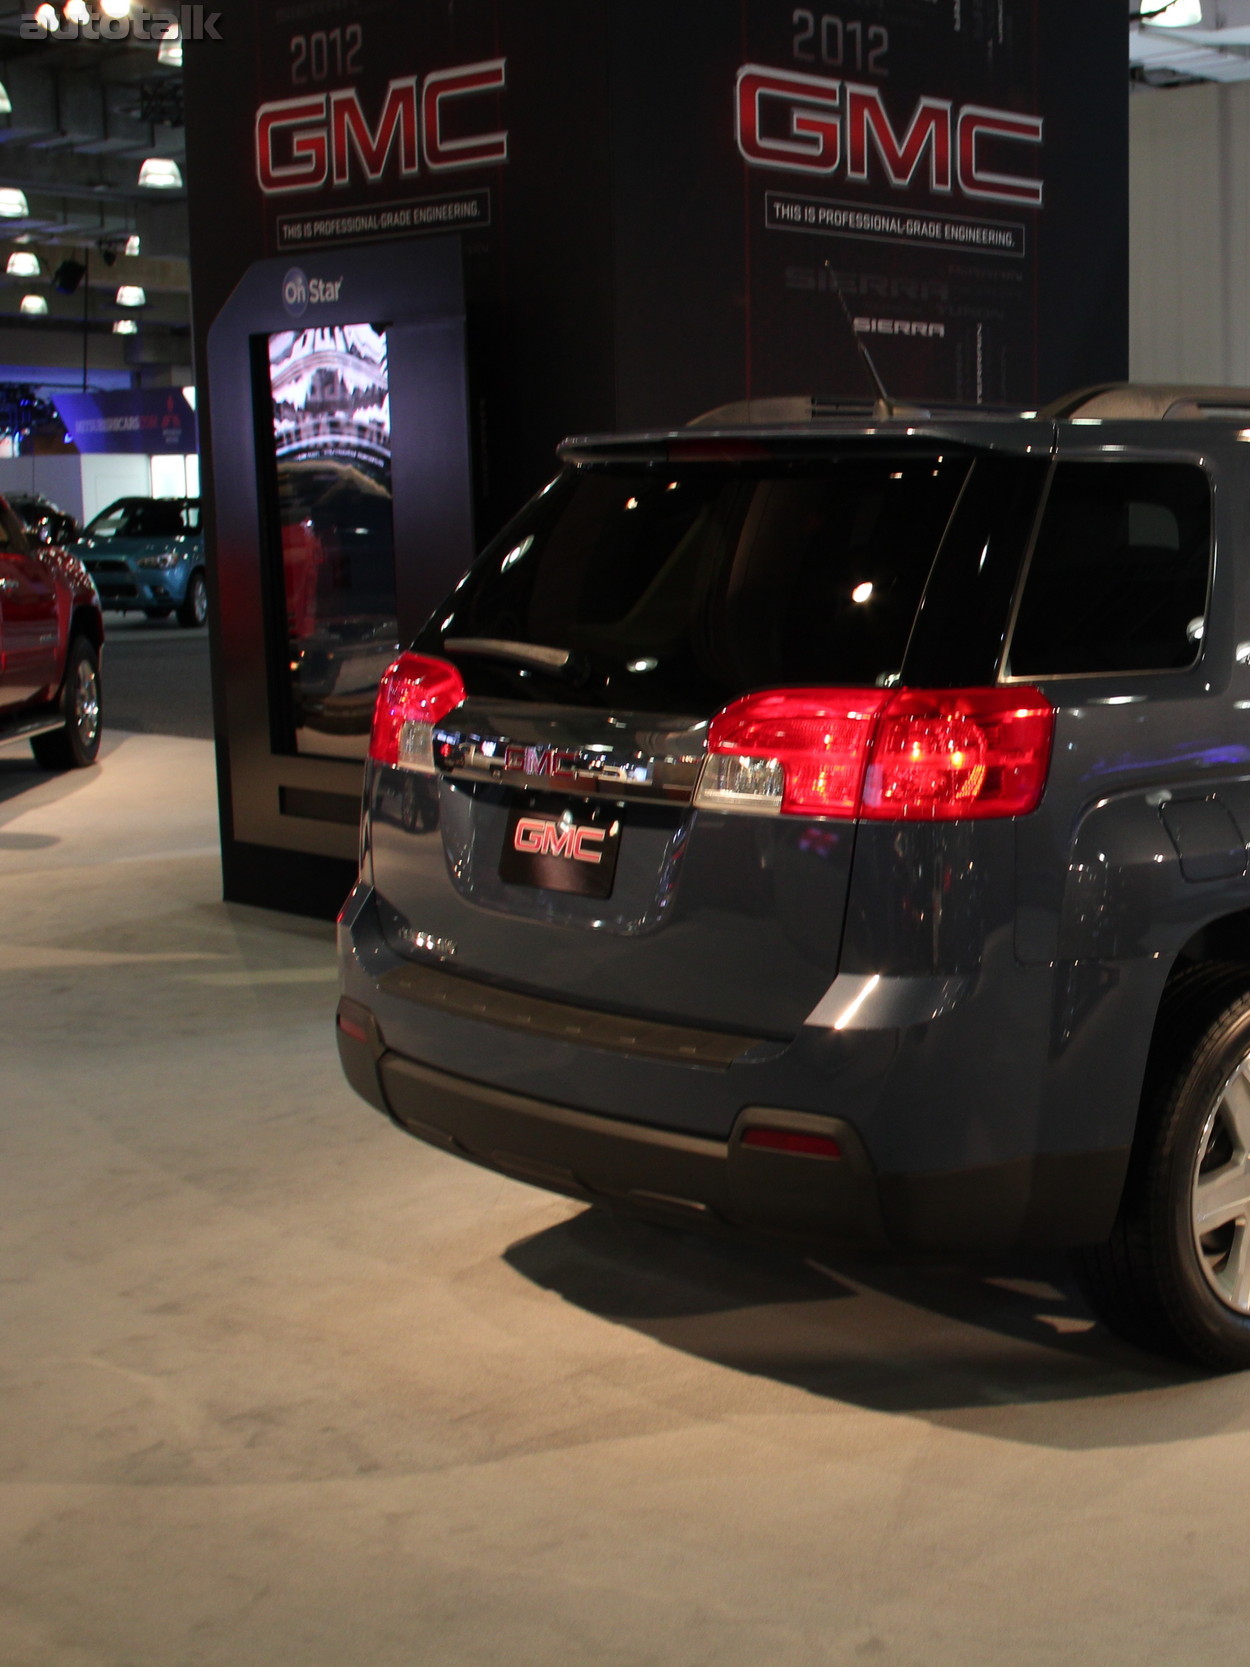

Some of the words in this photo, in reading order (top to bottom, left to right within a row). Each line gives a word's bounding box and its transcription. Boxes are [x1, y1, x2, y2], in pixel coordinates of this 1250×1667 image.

[291, 24, 364, 84] 2012
[792, 8, 890, 76] 2012
[256, 57, 508, 193] GMC
[735, 62, 1044, 205] GMC
[283, 223, 302, 240] THIS
[303, 222, 313, 238] IS
[773, 201, 801, 222] THIS
[804, 205, 816, 223] IS
[853, 317, 945, 338] SIERRA
[505, 744, 581, 780] GMC
[514, 816, 606, 864] GMC
